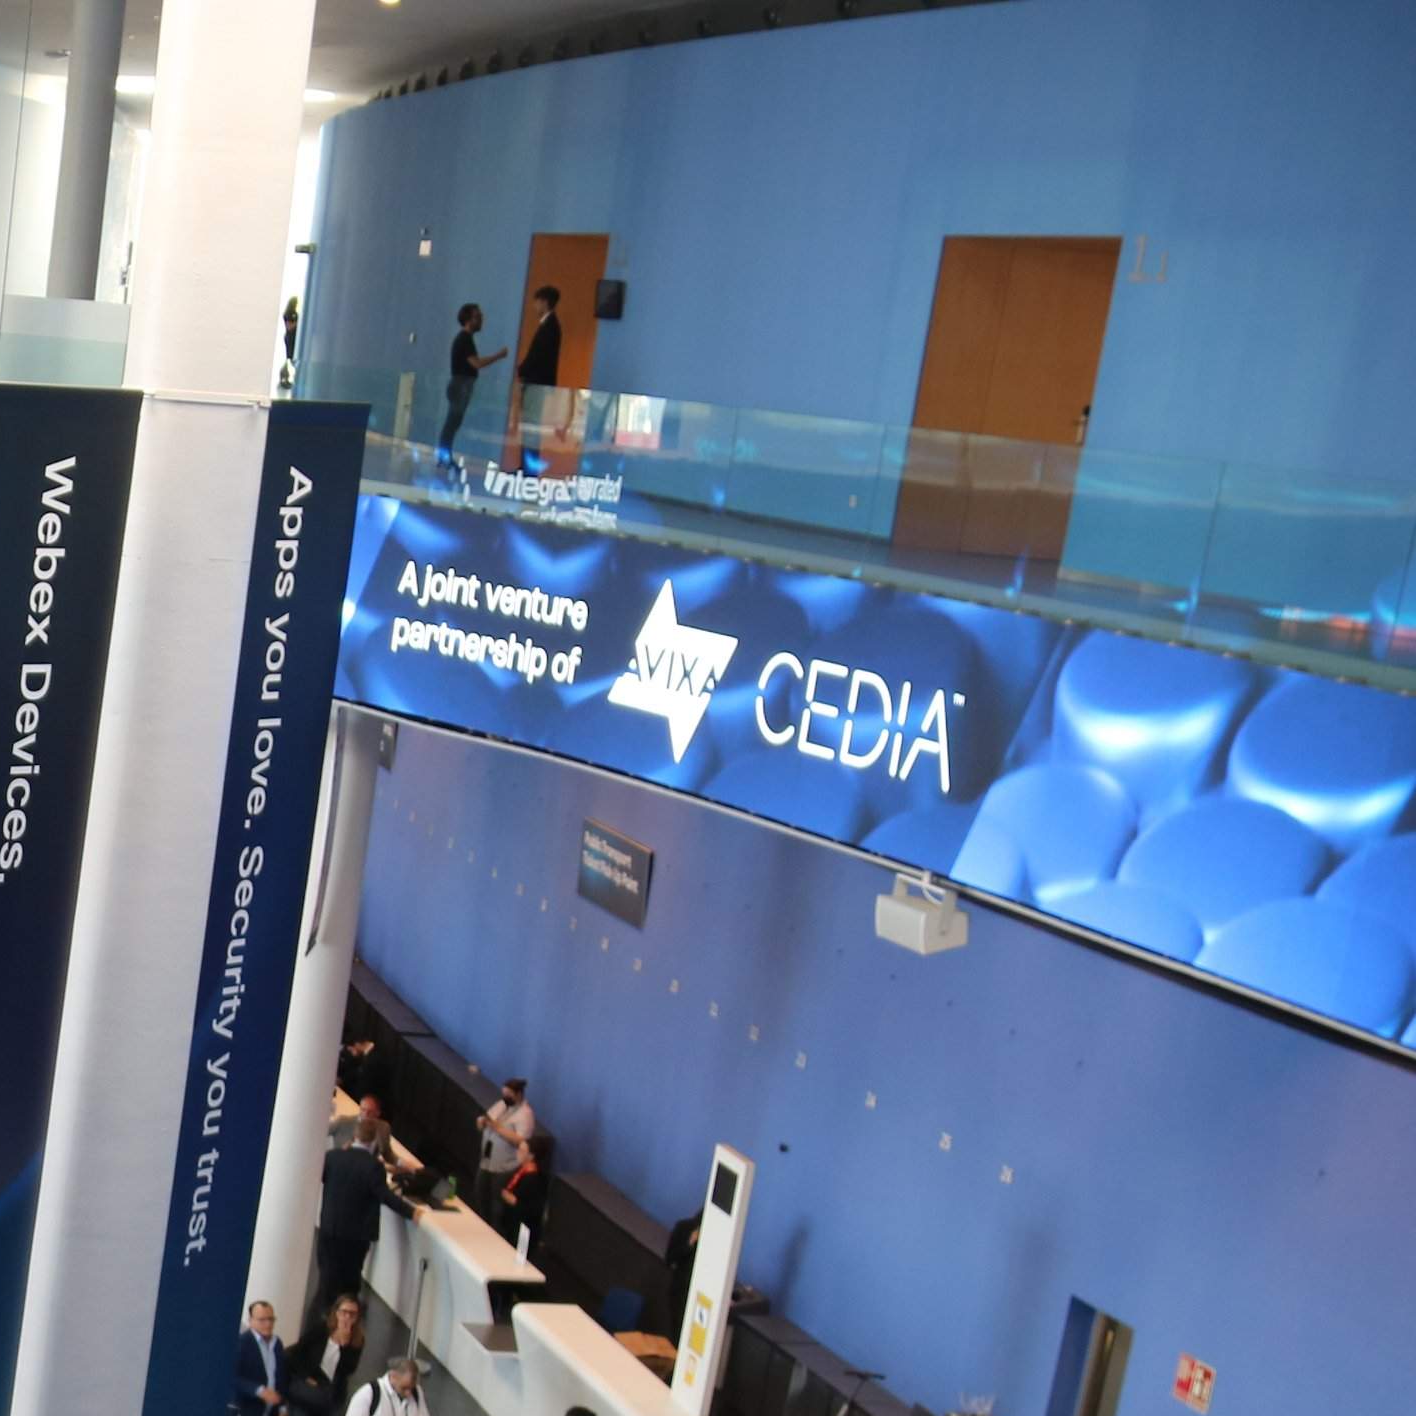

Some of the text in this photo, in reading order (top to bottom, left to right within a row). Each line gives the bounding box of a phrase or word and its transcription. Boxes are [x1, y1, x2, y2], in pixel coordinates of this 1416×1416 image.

[24, 455, 77, 646] Webex
[397, 560, 590, 631] A joint venture
[391, 615, 583, 684] partnership of
[183, 466, 314, 1267] Apps you love. Security you trust.
